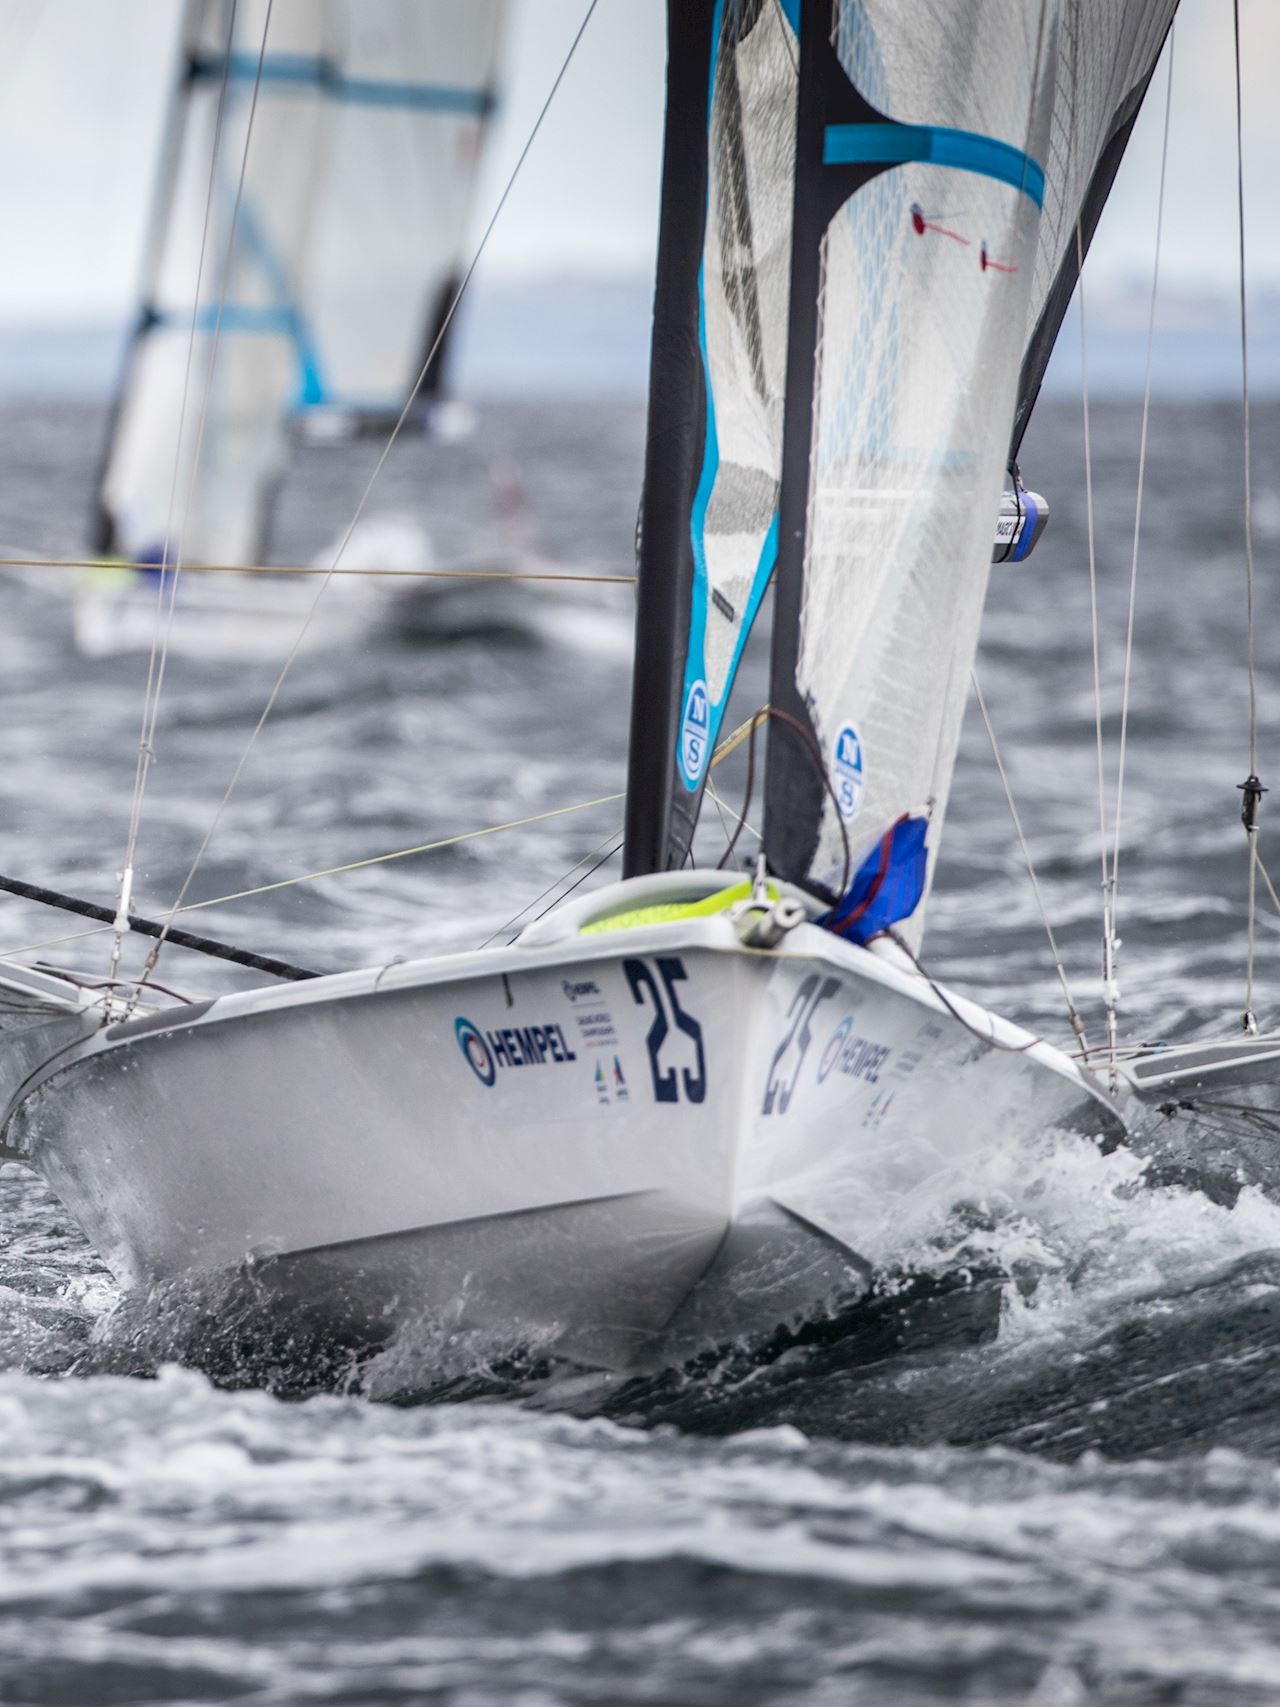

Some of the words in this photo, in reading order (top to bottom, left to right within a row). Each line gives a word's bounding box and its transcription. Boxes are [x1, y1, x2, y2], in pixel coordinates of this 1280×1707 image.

[486, 1023, 576, 1067] HEMPEL
[622, 956, 707, 1104] 25
[761, 974, 844, 1115] 25
